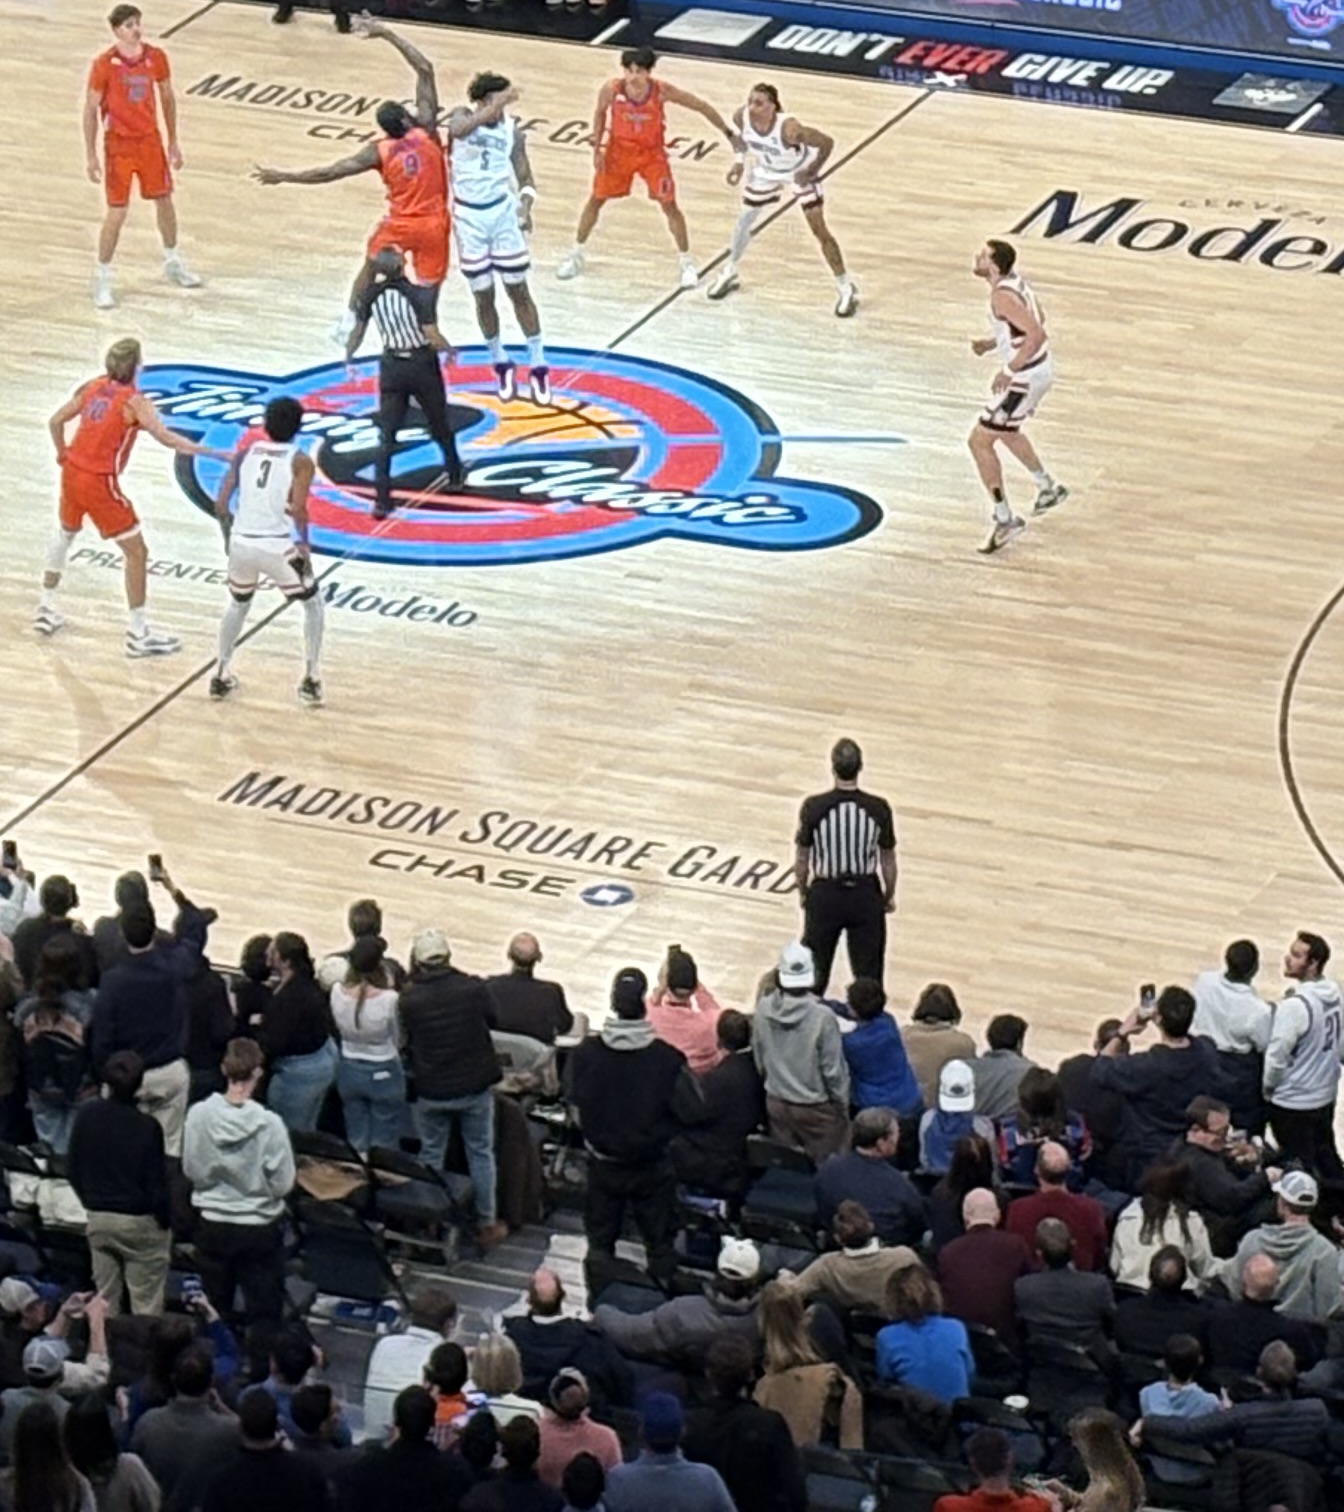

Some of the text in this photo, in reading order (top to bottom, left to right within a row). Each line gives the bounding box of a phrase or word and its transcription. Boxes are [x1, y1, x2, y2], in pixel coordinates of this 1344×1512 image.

[766, 23, 905, 61] DON'T
[893, 40, 1010, 75] EVER
[1001, 52, 1111, 88] GIVE
[185, 73, 380, 116] MADISON
[256, 459, 272, 489] 3
[464, 460, 797, 523] Classic
[320, 581, 479, 629] Modelo
[217, 770, 798, 896] MADISON SQUARE GARD
[367, 849, 580, 898] CHASE
